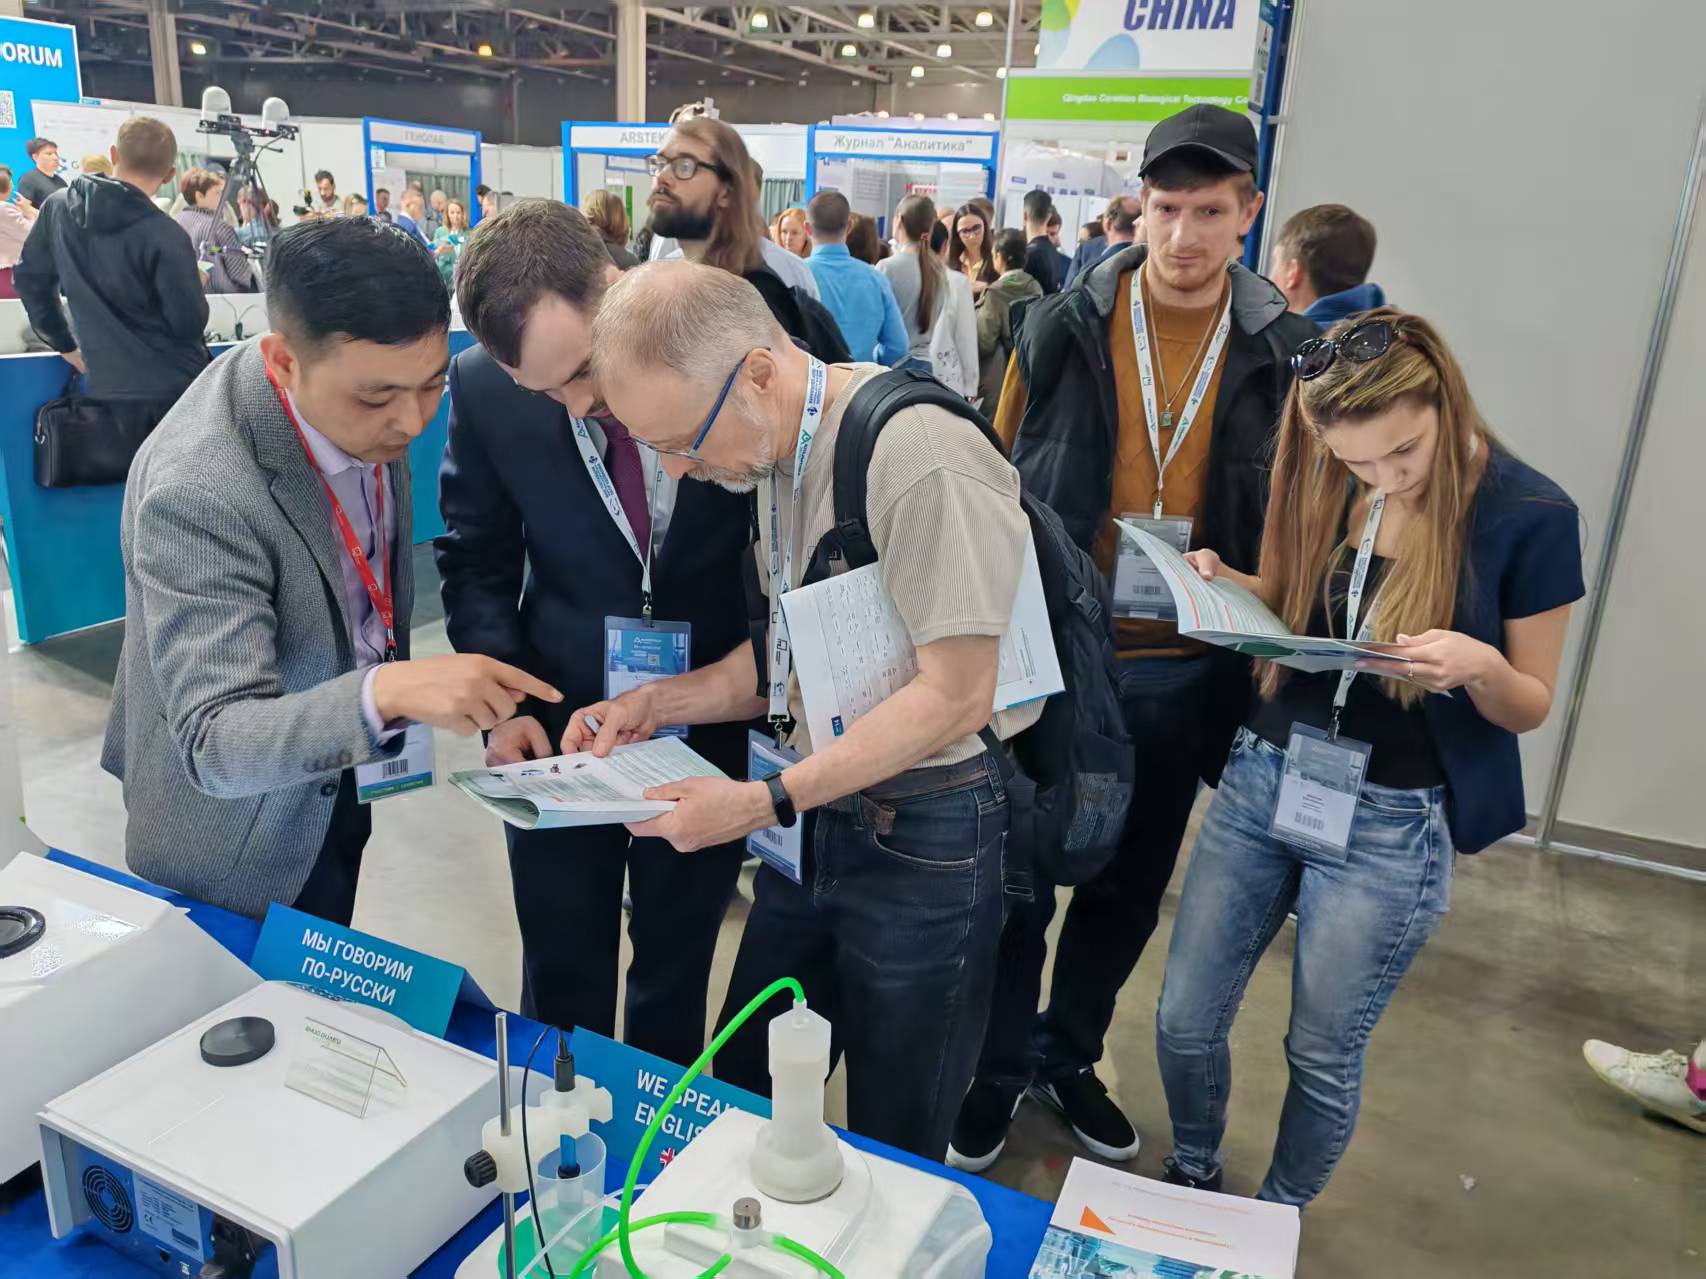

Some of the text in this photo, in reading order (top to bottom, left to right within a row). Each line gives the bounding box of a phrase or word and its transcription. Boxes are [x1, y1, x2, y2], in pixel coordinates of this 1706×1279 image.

[1123, 0, 1236, 31] CHINA
[0, 41, 63, 68] ORUM
[833, 135, 973, 152] Журнал "Аналитика"
[301, 928, 415, 983] МЫ ГОВОРИМ
[301, 956, 398, 1006] ПО-РУССКИ
[637, 1068, 668, 1099] WE
[634, 1101, 705, 1143] ENGLIS
